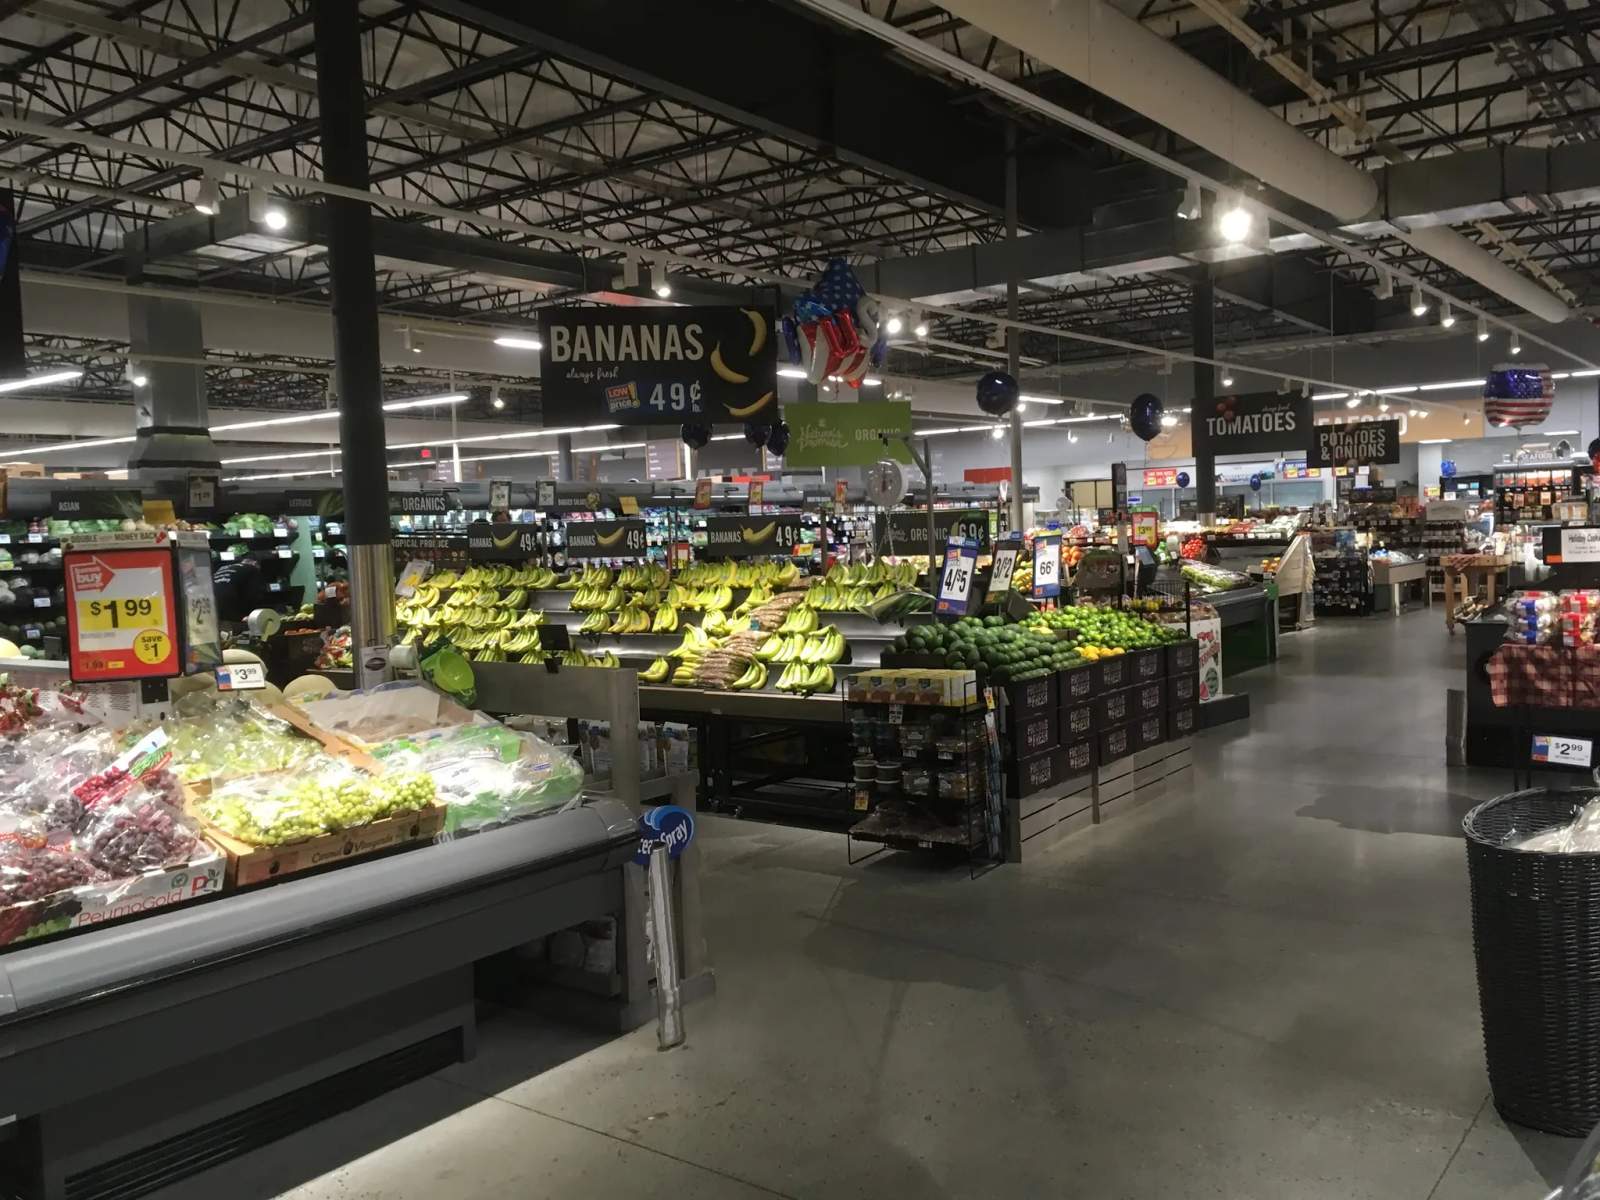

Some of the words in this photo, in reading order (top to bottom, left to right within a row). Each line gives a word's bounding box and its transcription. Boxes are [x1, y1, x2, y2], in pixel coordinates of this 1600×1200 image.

[550, 323, 704, 363] BANANAS
[1206, 411, 1296, 437] TOMATOES
[1320, 428, 1386, 447] POTATOES
[1320, 447, 1330, 461] &
[1334, 443, 1386, 460] ONIONS
[59, 501, 80, 511] ASIAN
[402, 497, 446, 511] ORGANICS
[710, 532, 741, 543] BANANAS
[910, 527, 948, 541] ORGNIC
[469, 537, 493, 548] BANANAS
[569, 536, 596, 547] BANANAS
[144, 643, 158, 657] $1
[660, 820, 688, 854] Spray
[78, 886, 183, 927] PeumoGold
